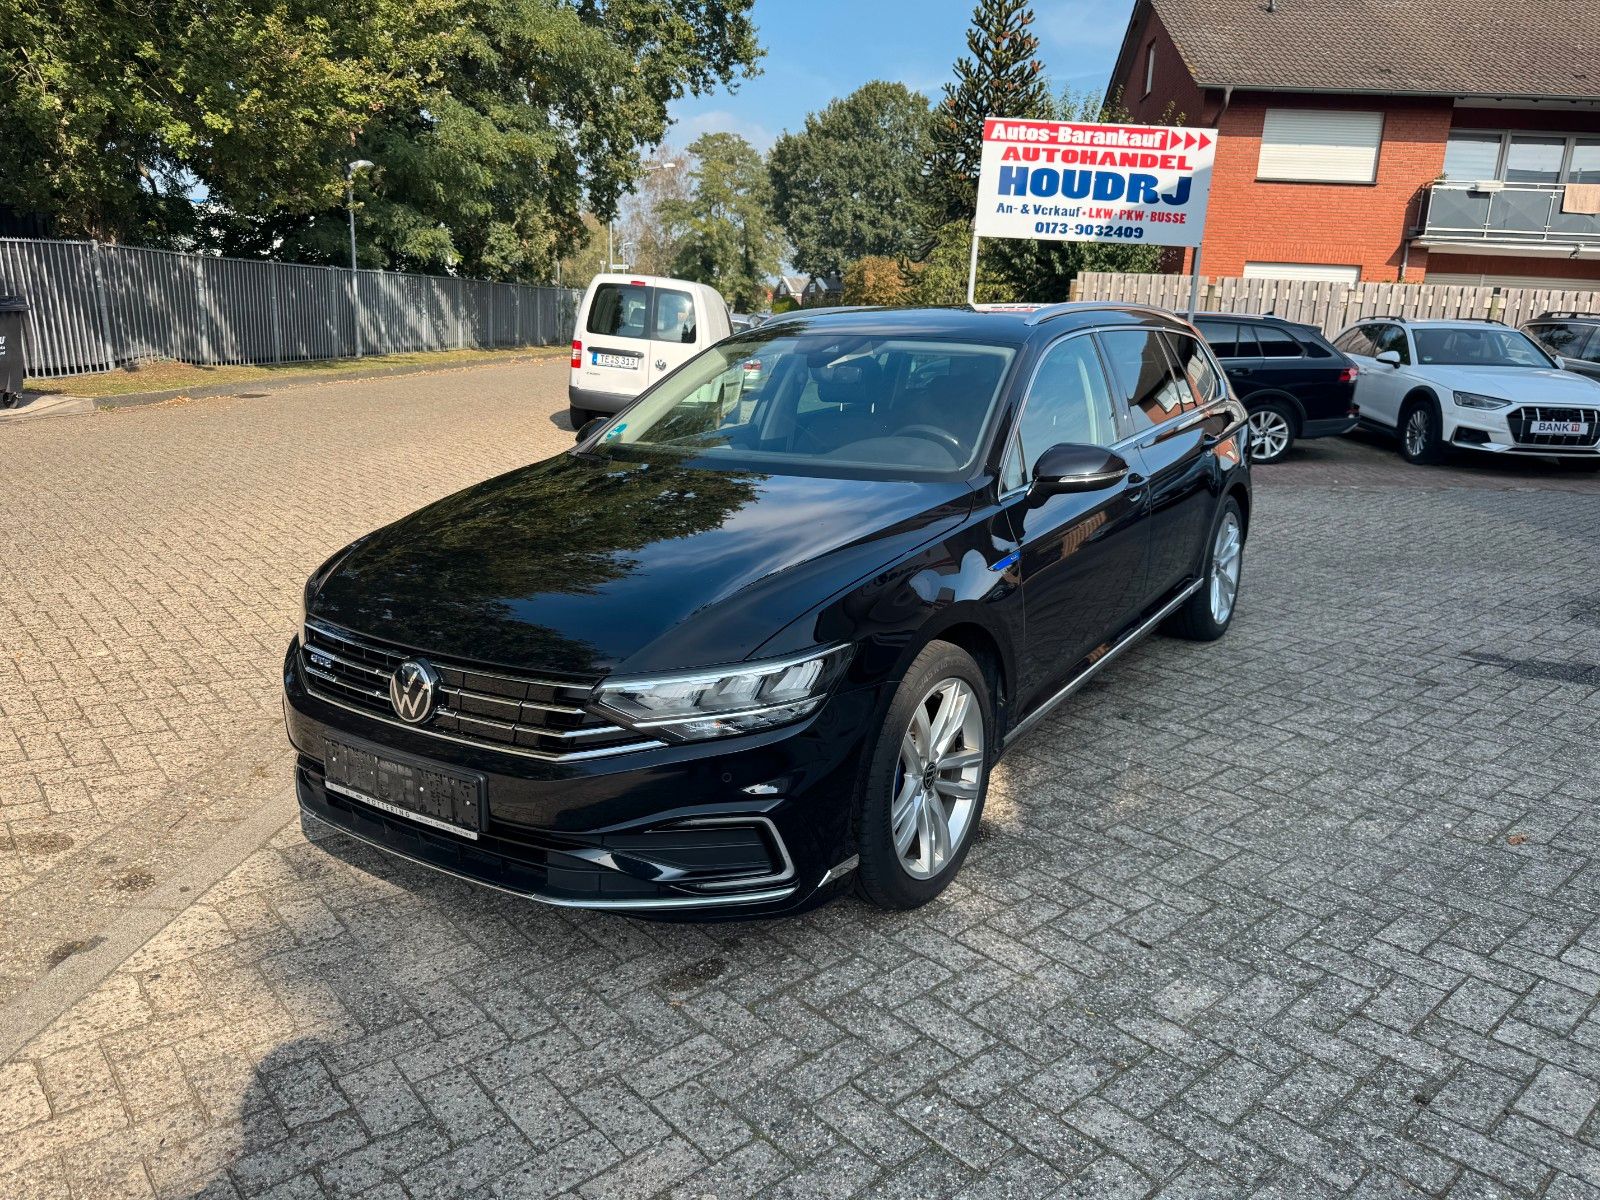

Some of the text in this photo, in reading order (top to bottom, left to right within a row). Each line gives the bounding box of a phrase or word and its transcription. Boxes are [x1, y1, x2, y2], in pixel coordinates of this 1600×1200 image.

[990, 122, 1166, 149] Autos-Barankauf
[1001, 146, 1193, 171] AUTOHANDEL
[997, 165, 1193, 206] HOUDRJ
[996, 202, 1187, 224] An- & Verkauf LKW PKW BUSSE
[1034, 221, 1144, 239] 0173-9032409
[1538, 422, 1570, 432] BANK
